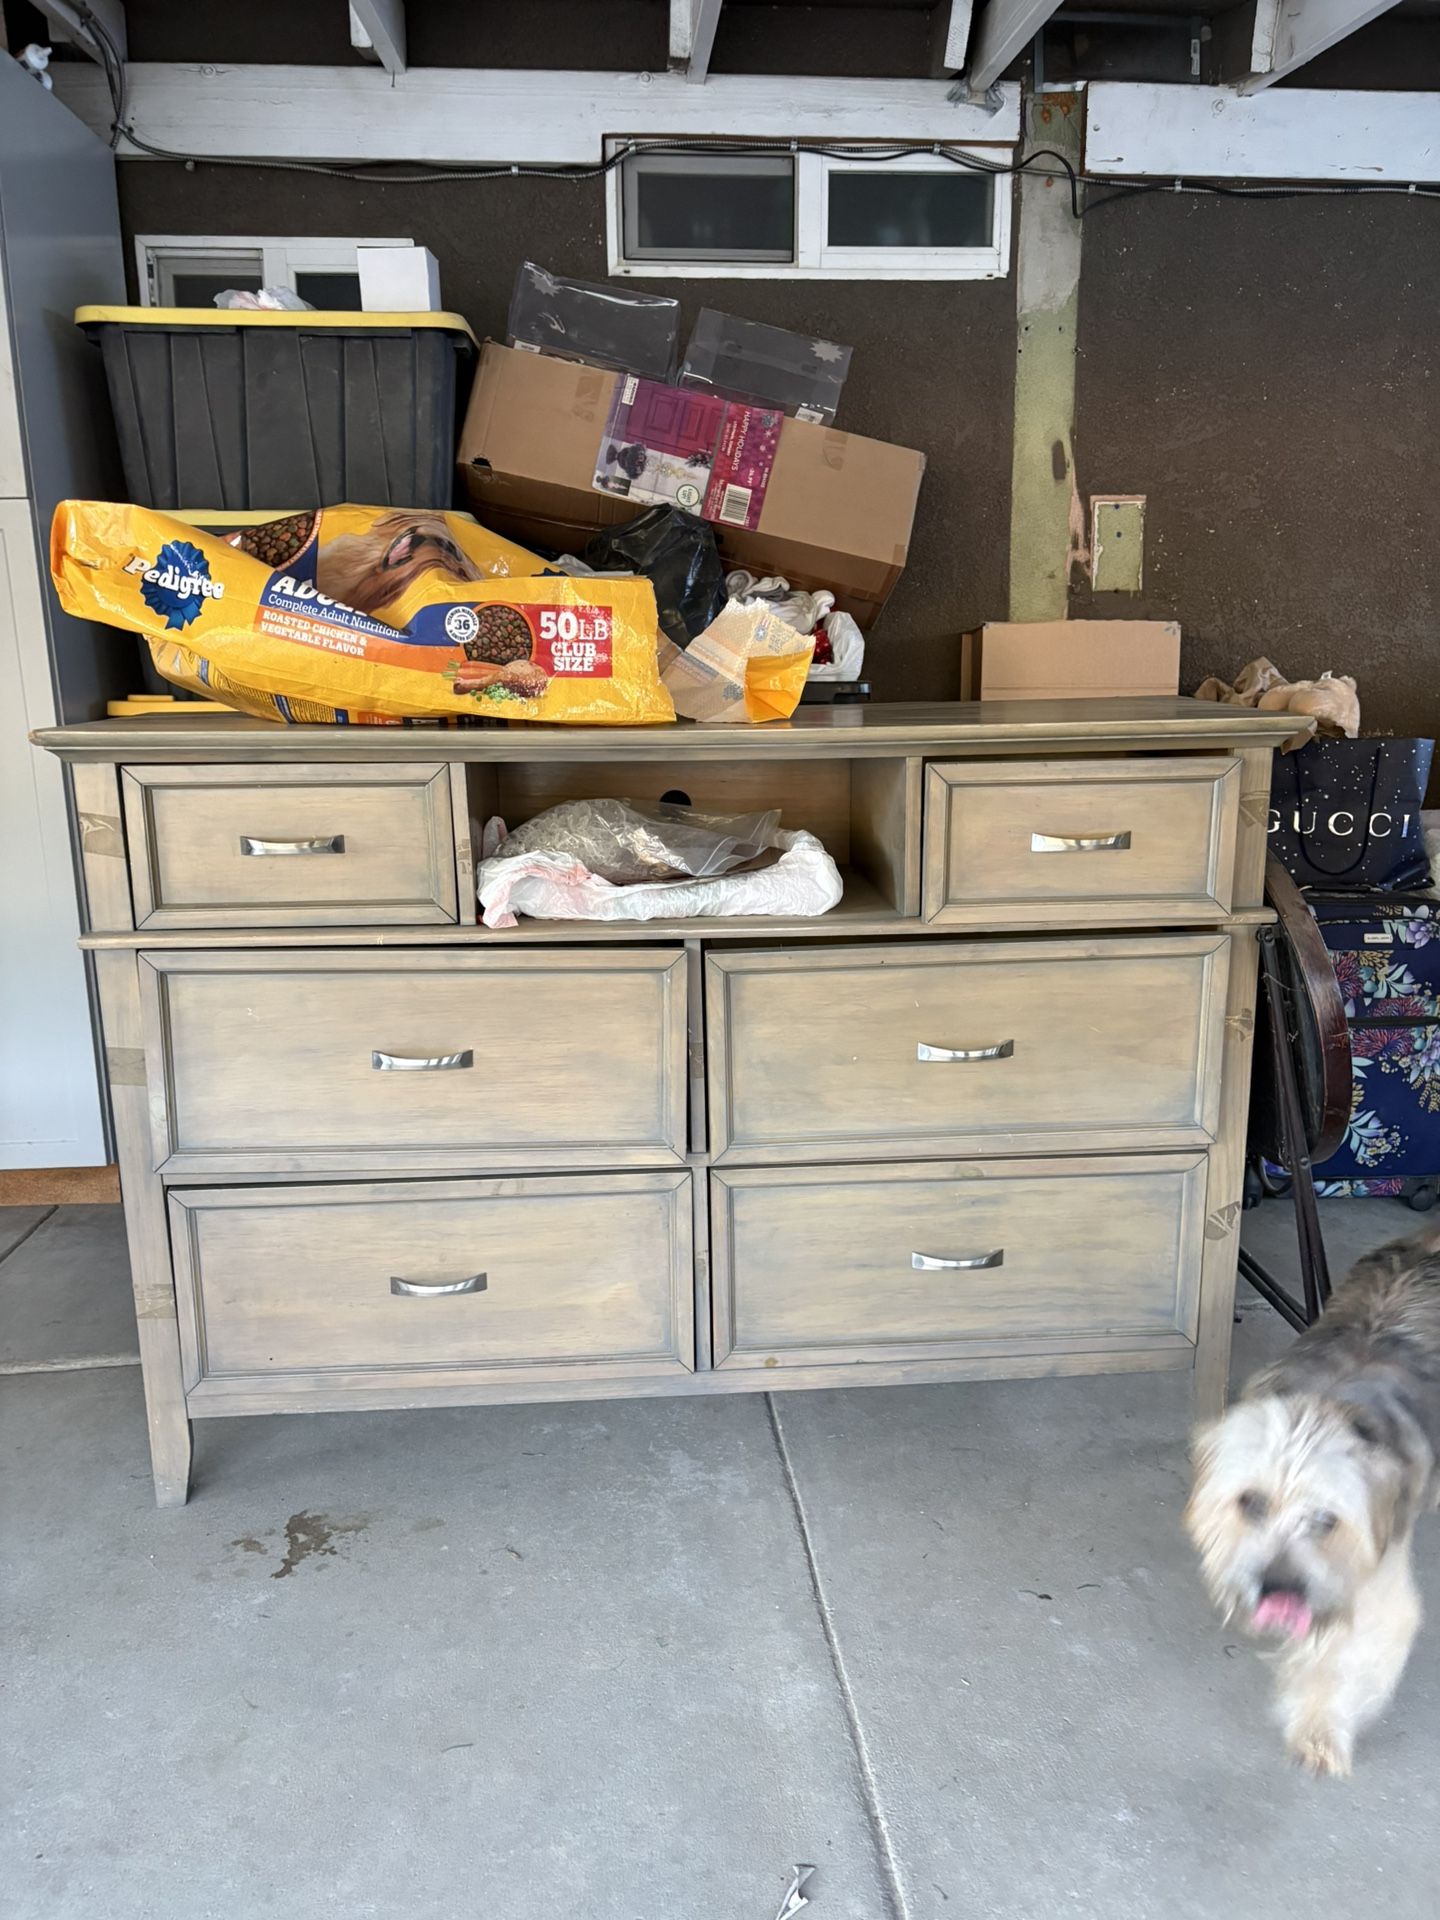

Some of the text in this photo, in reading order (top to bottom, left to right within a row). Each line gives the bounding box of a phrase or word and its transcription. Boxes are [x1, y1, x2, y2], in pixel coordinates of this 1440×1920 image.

[740, 410, 751, 435] HAPPY
[731, 437, 746, 471] HOLIDAYS
[122, 555, 225, 600] Pedigree
[263, 610, 368, 647] ROASTED CHICKEN &
[268, 593, 400, 639] Complete Adult Nutrition
[454, 618, 471, 631] 36
[261, 621, 365, 657] VEGETABLE FLAVOR
[551, 641, 597, 657] CLUB
[553, 656, 594, 672] SIZE
